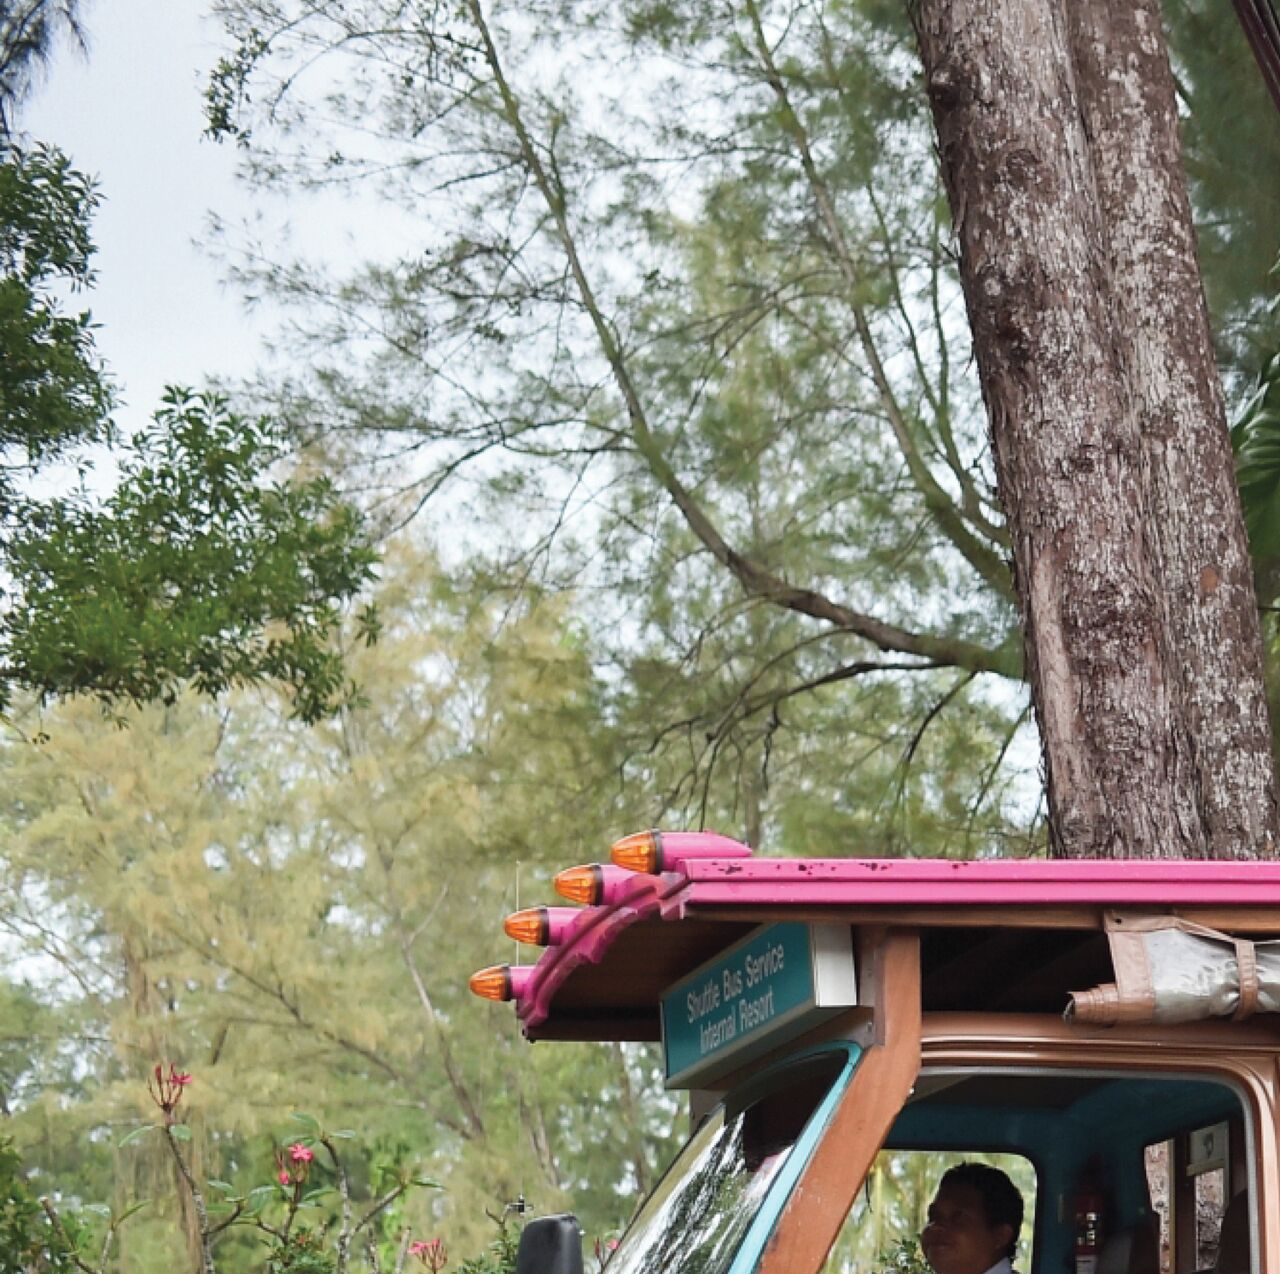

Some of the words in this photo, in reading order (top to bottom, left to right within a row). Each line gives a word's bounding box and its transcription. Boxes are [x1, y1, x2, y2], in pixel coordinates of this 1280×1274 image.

[687, 979, 720, 1024] Shuttle
[723, 969, 742, 1002] Bus
[744, 942, 785, 989] Service
[700, 1005, 737, 1054] Internal
[739, 985, 775, 1032] Resort
